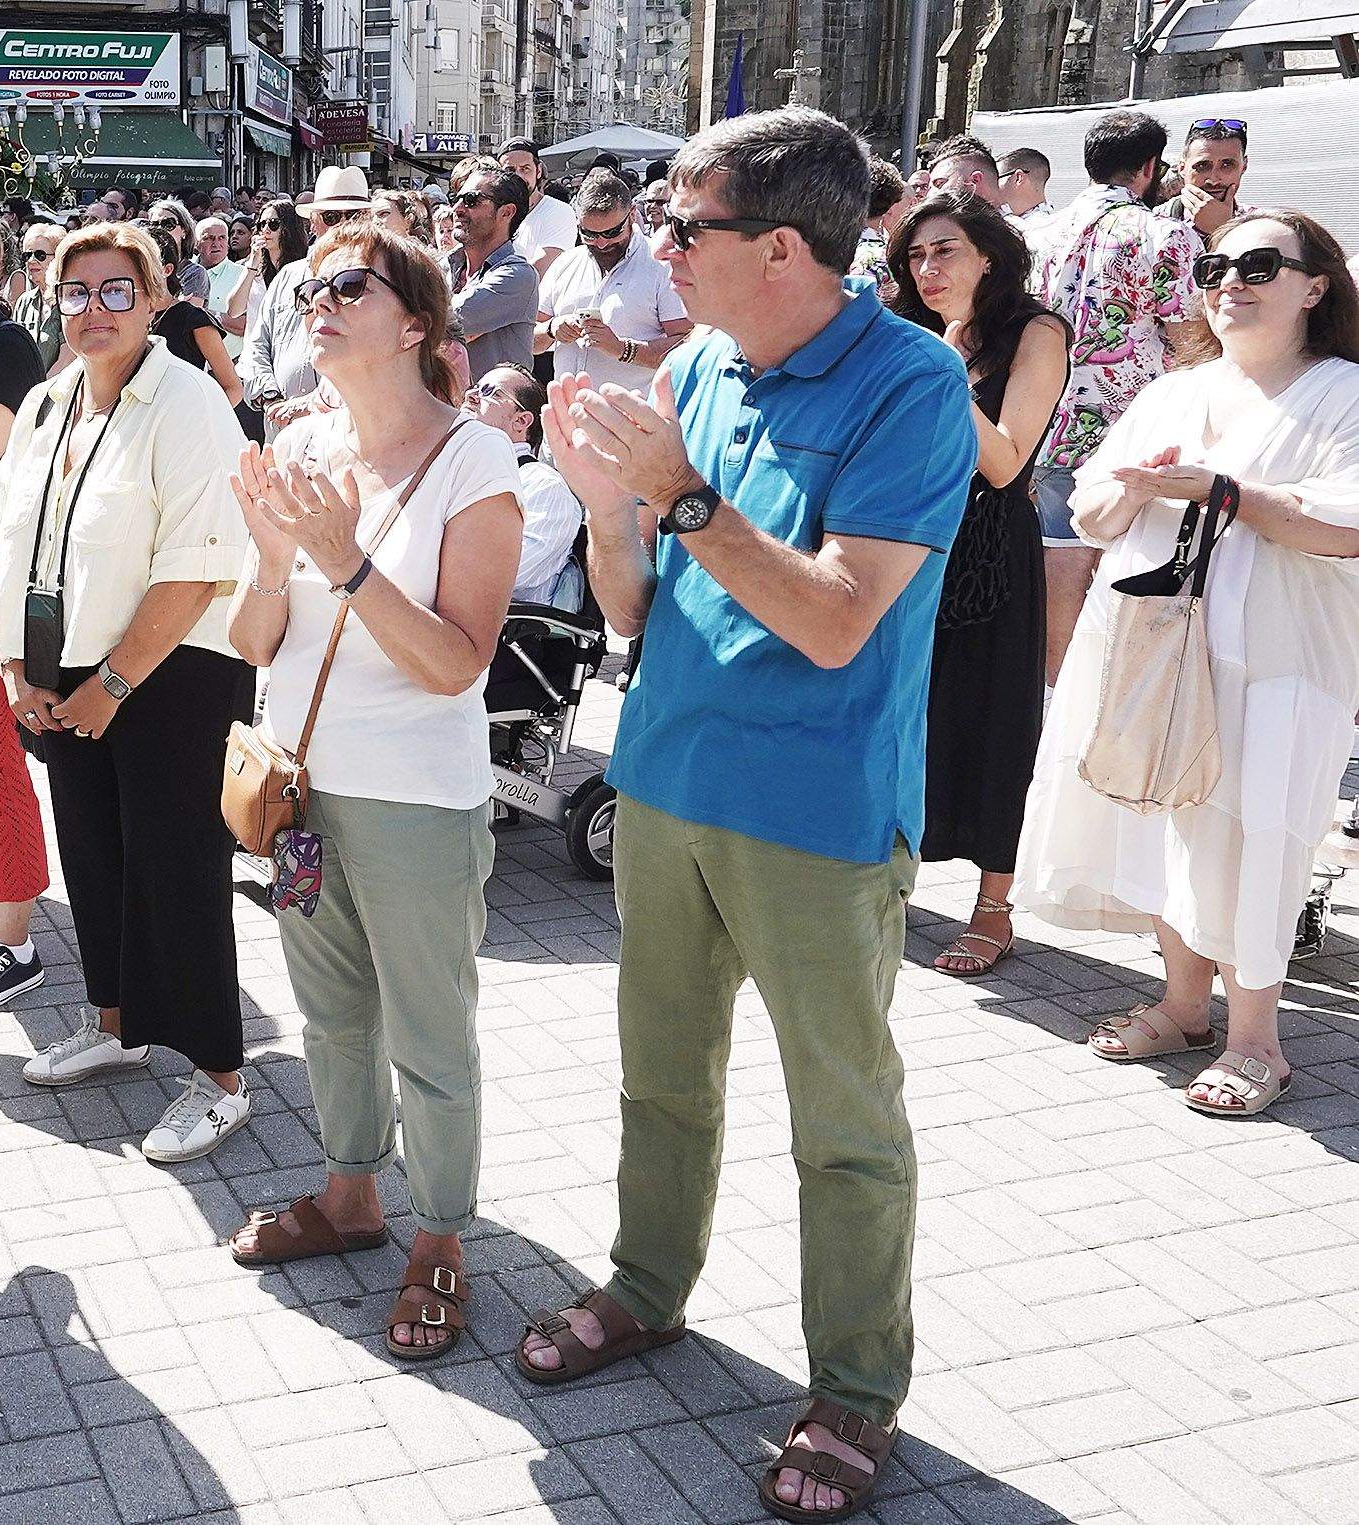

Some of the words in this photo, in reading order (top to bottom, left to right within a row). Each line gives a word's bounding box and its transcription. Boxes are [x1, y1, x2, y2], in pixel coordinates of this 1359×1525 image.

[101, 41, 153, 59] FUJI
[8, 70, 60, 80] REVELADO
[62, 70, 88, 81] FOTO
[89, 71, 125, 81] DIGITAL
[149, 80, 169, 89] FOTO
[144, 91, 176, 100] OLIMPIO
[70, 168, 109, 183] Olimpio
[495, 775, 539, 806] orolla
